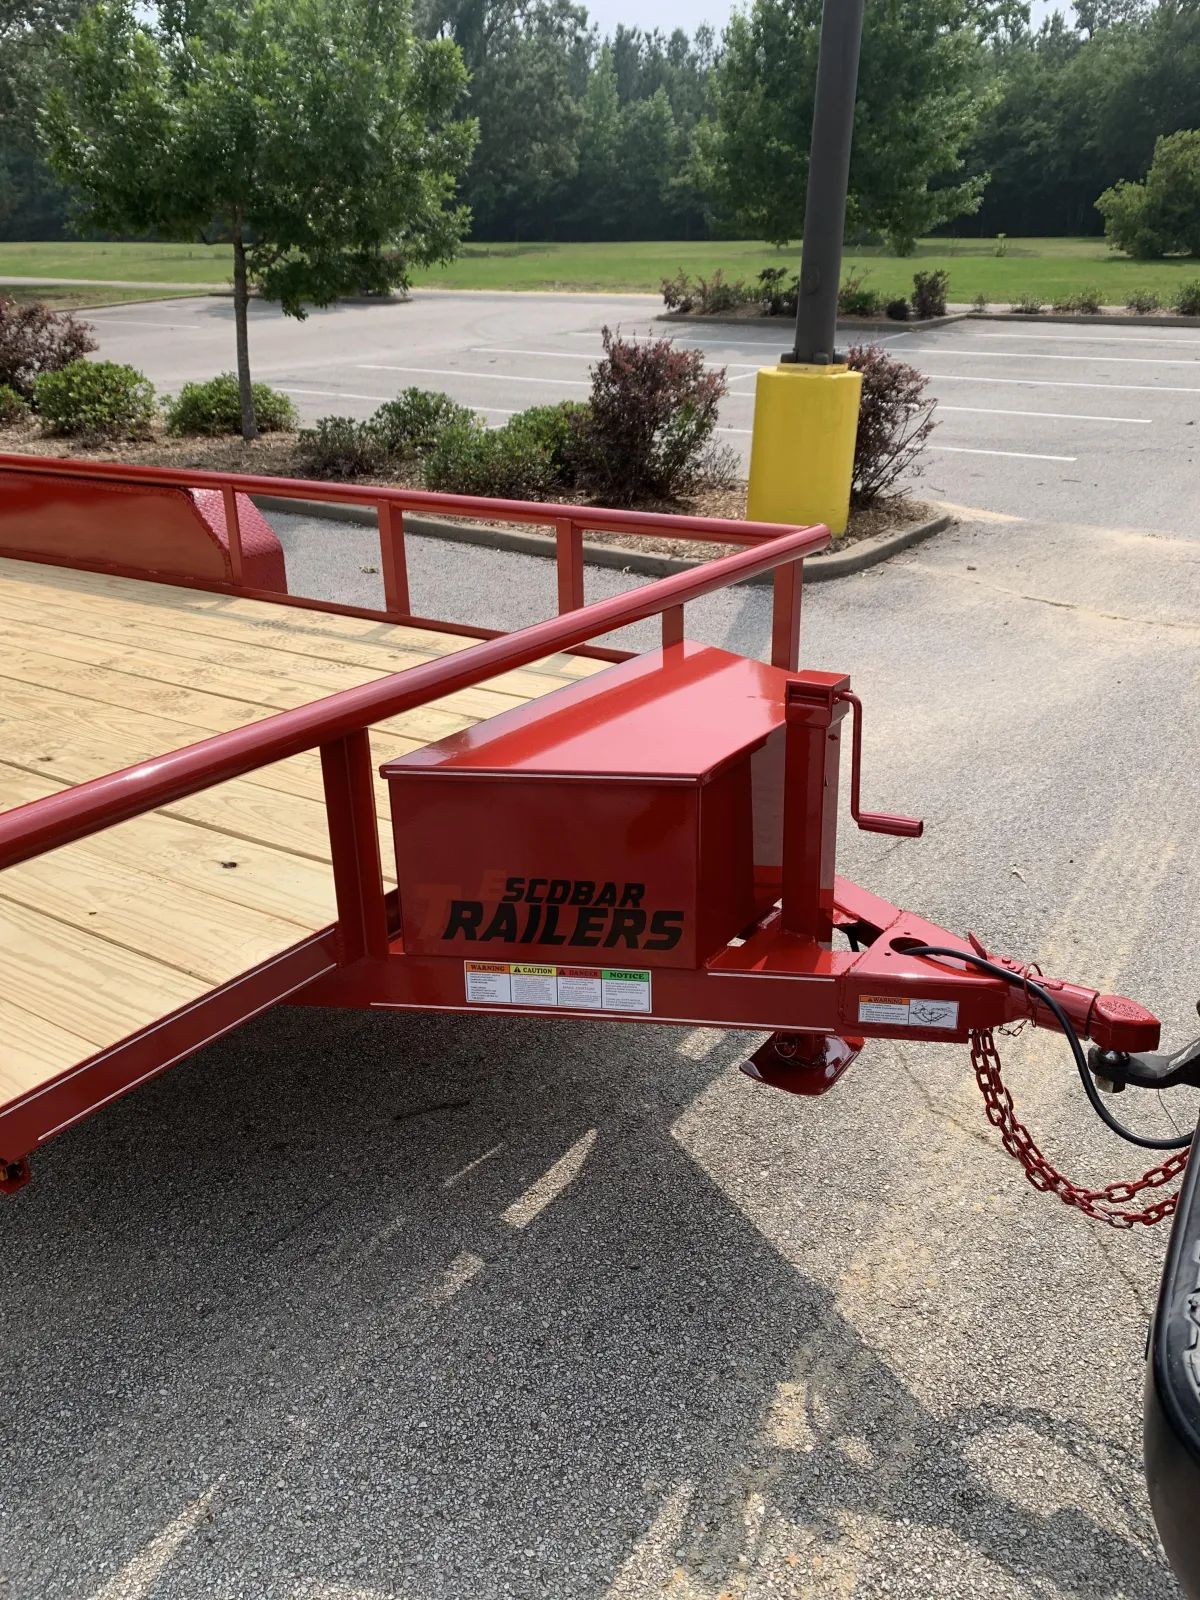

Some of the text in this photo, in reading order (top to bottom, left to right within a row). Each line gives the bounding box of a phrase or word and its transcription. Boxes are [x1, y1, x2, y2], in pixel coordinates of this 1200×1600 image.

[471, 964, 505, 972] WARNING
[569, 969, 598, 977] DANGER
[609, 971, 645, 980] NOTICE
[873, 997, 903, 1005] WARNING
